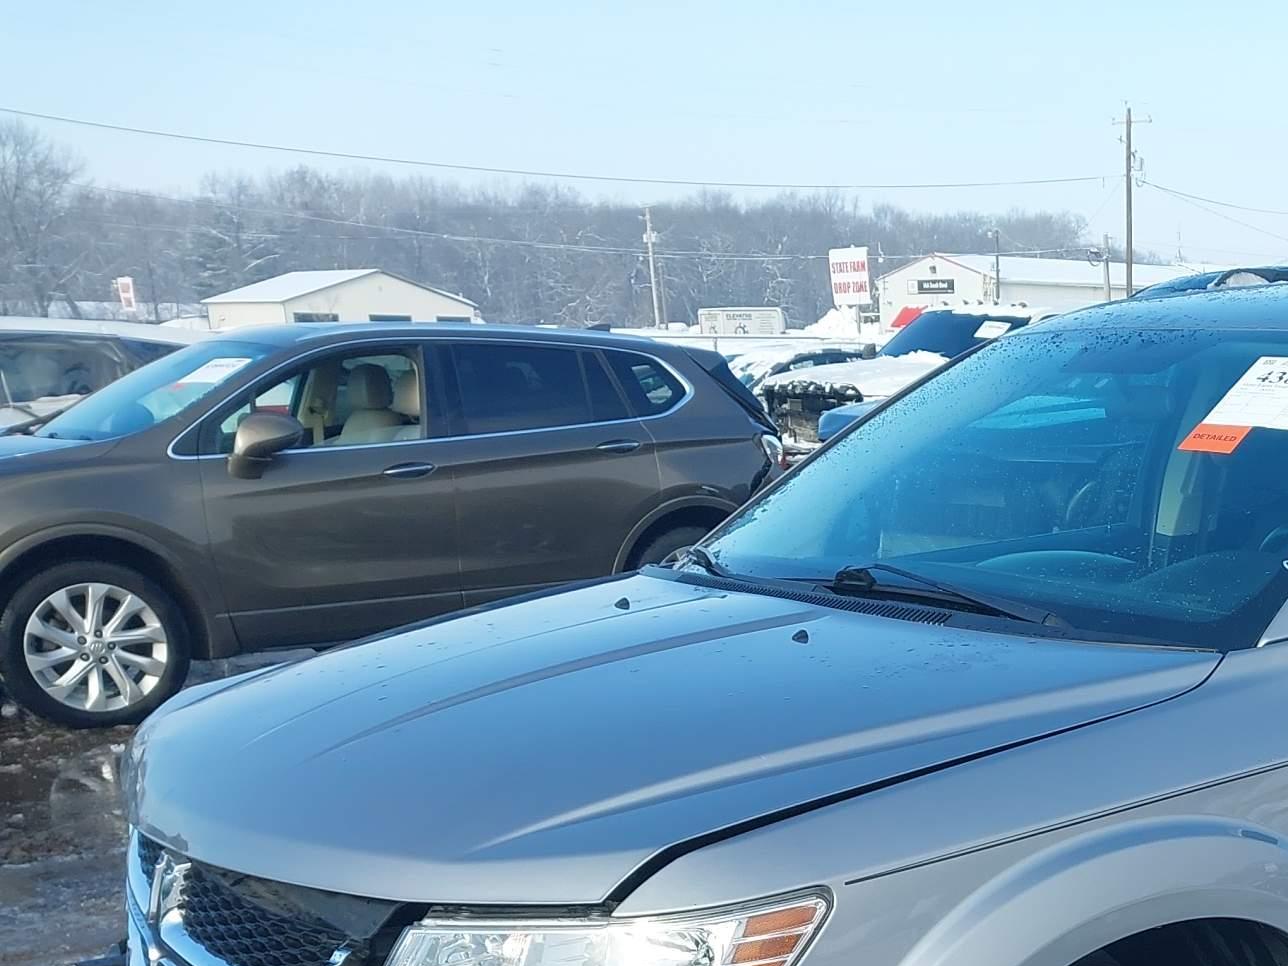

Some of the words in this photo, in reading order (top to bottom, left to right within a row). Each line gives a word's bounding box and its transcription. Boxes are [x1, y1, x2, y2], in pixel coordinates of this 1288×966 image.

[831, 261, 848, 274] STATE
[850, 260, 866, 272] FARM
[834, 281, 850, 294] DROP
[852, 280, 868, 293] ZONE
[1193, 433, 1237, 442] DETAILED
